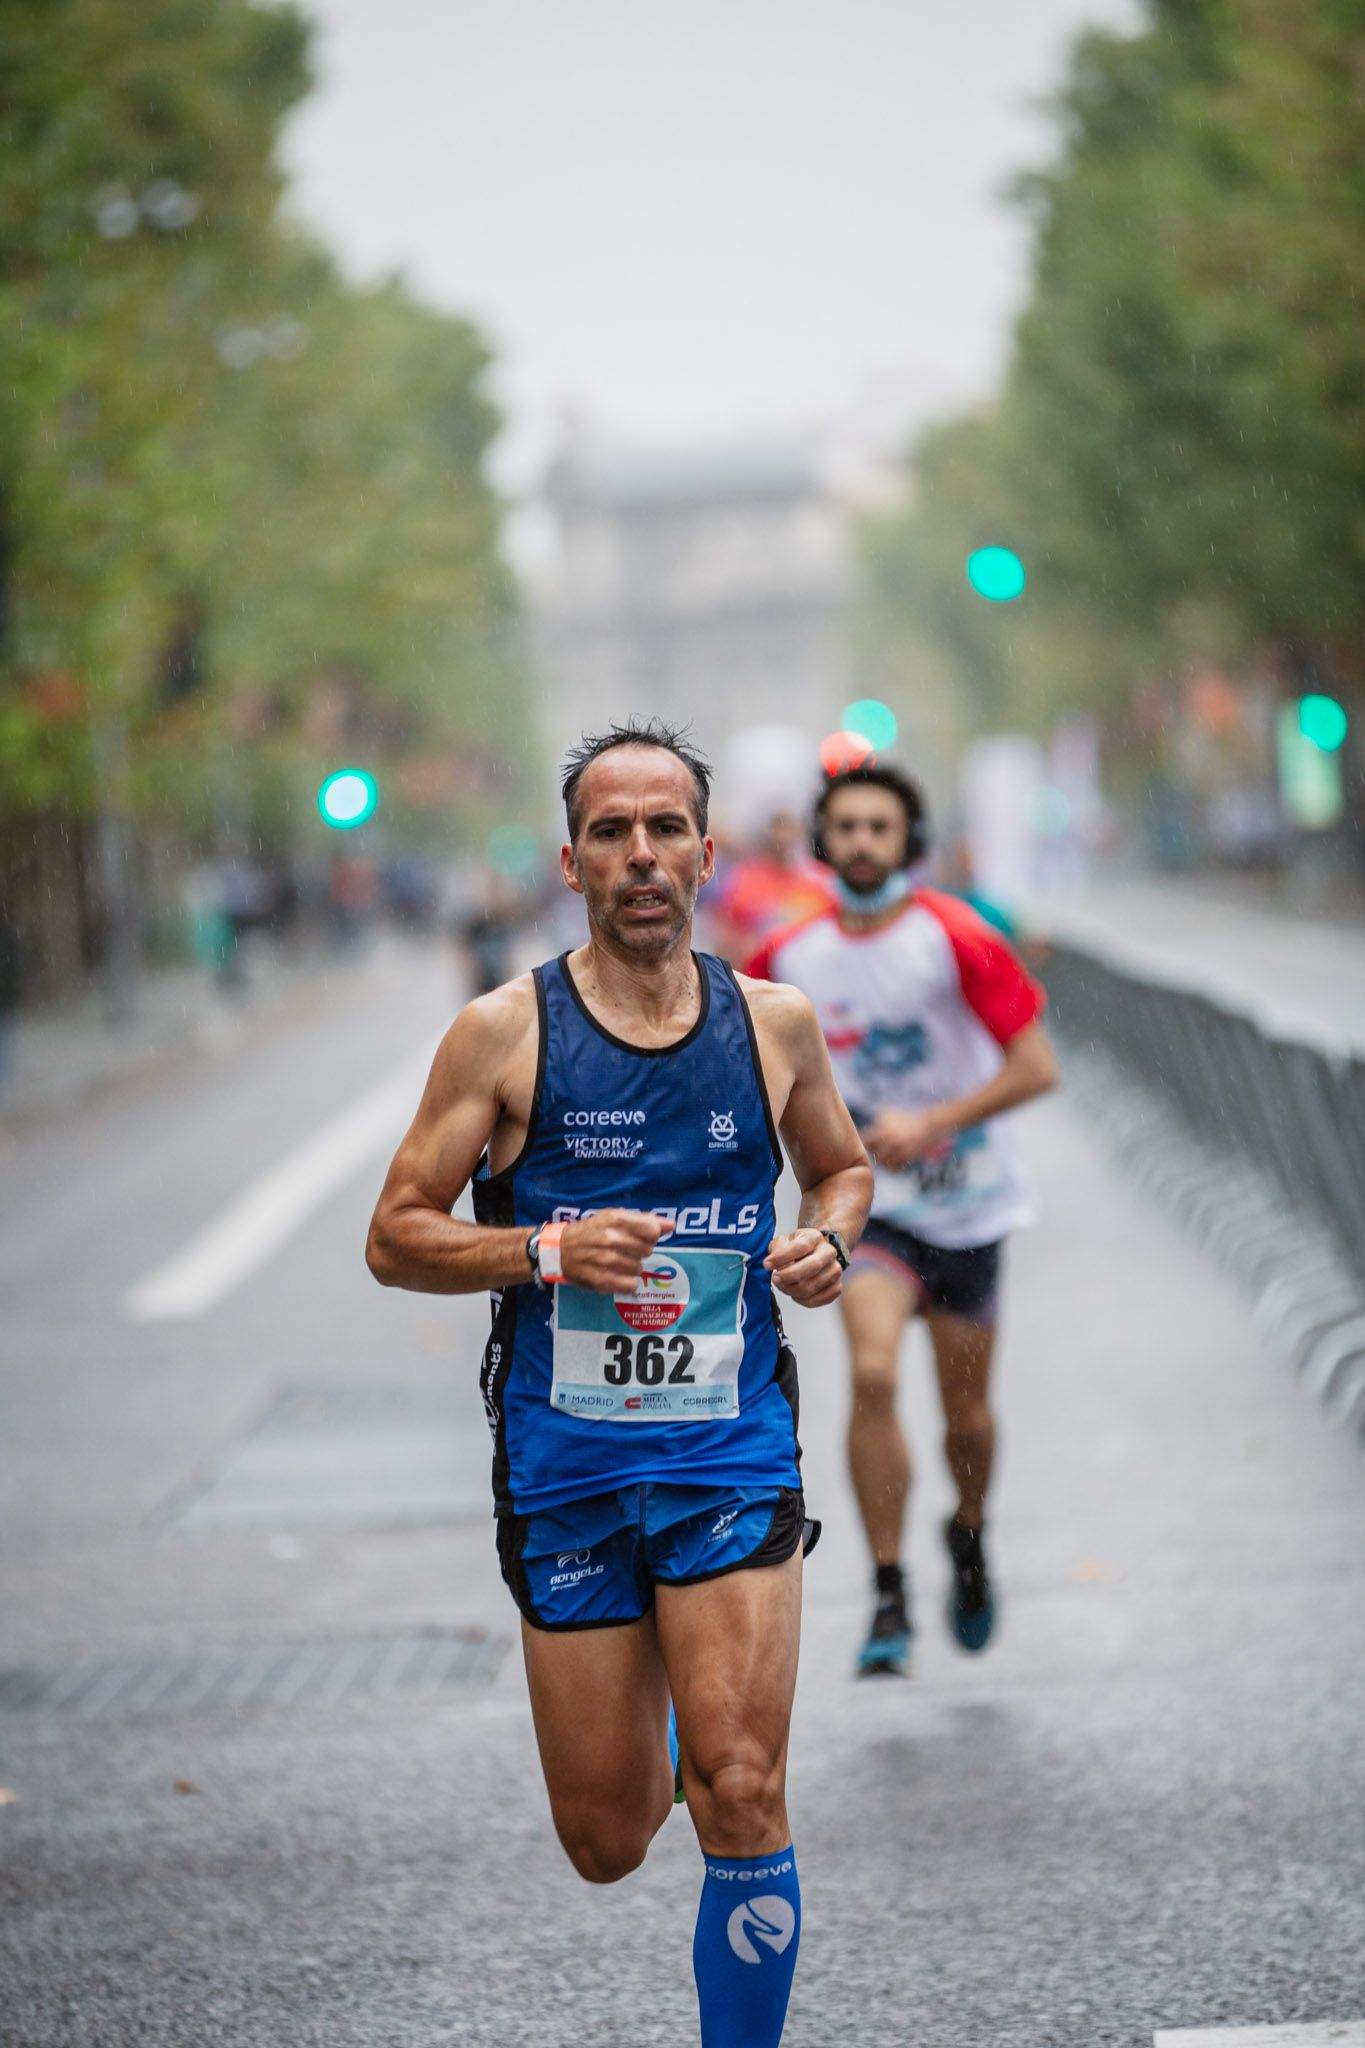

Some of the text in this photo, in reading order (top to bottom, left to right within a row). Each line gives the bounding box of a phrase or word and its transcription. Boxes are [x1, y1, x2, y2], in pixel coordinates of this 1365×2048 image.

[564, 1110, 646, 1126] coreevo
[564, 1137, 631, 1150] VICTORY
[574, 1149, 637, 1159] ENDURANCE
[604, 1335, 695, 1386] 362
[572, 1395, 614, 1407] MADRID
[708, 1861, 792, 1881] coreevo
